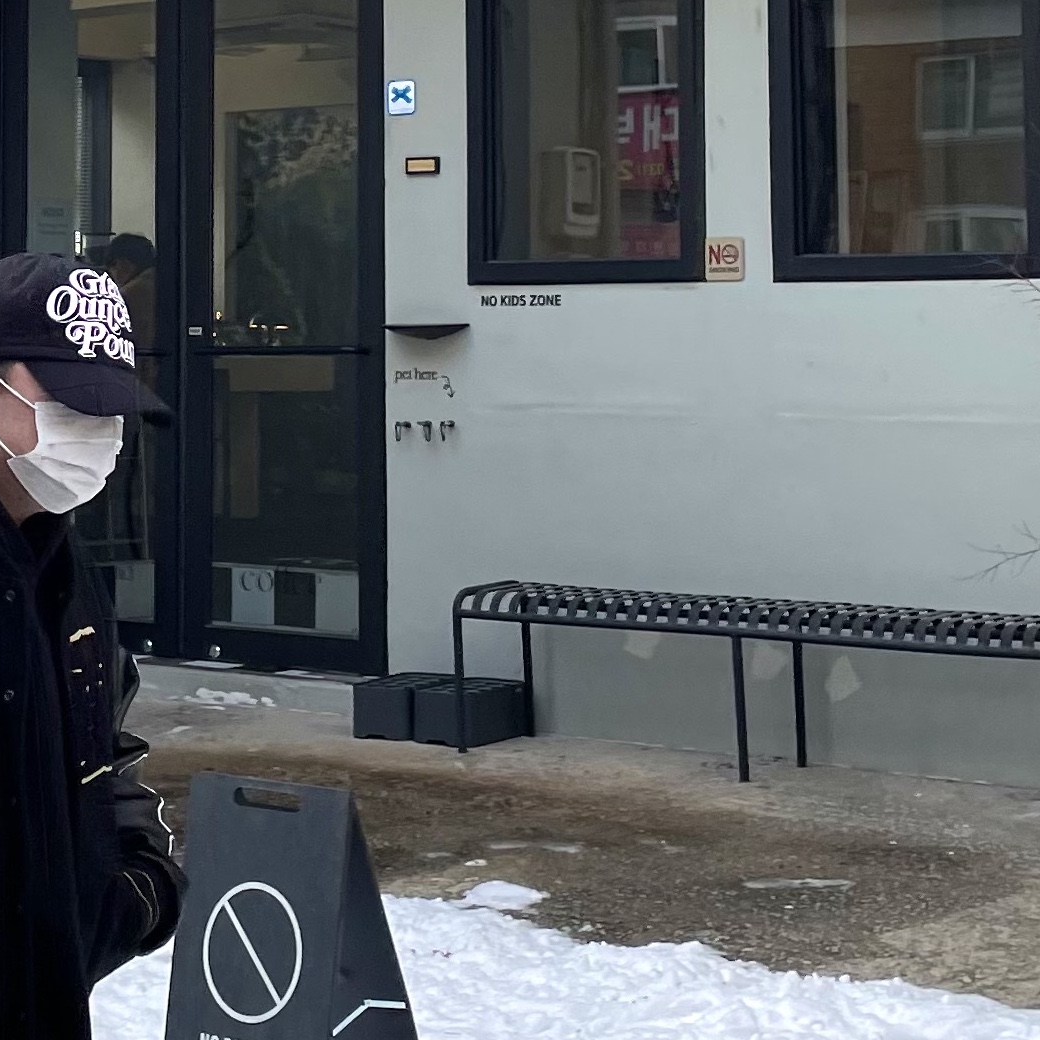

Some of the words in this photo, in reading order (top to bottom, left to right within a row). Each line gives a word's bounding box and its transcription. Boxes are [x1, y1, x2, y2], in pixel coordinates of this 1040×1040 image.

[480, 295, 498, 307] NO
[500, 294, 527, 307] KIDS
[529, 294, 562, 307] ZONE
[65, 320, 136, 369] Poun
[414, 367, 438, 381] here
